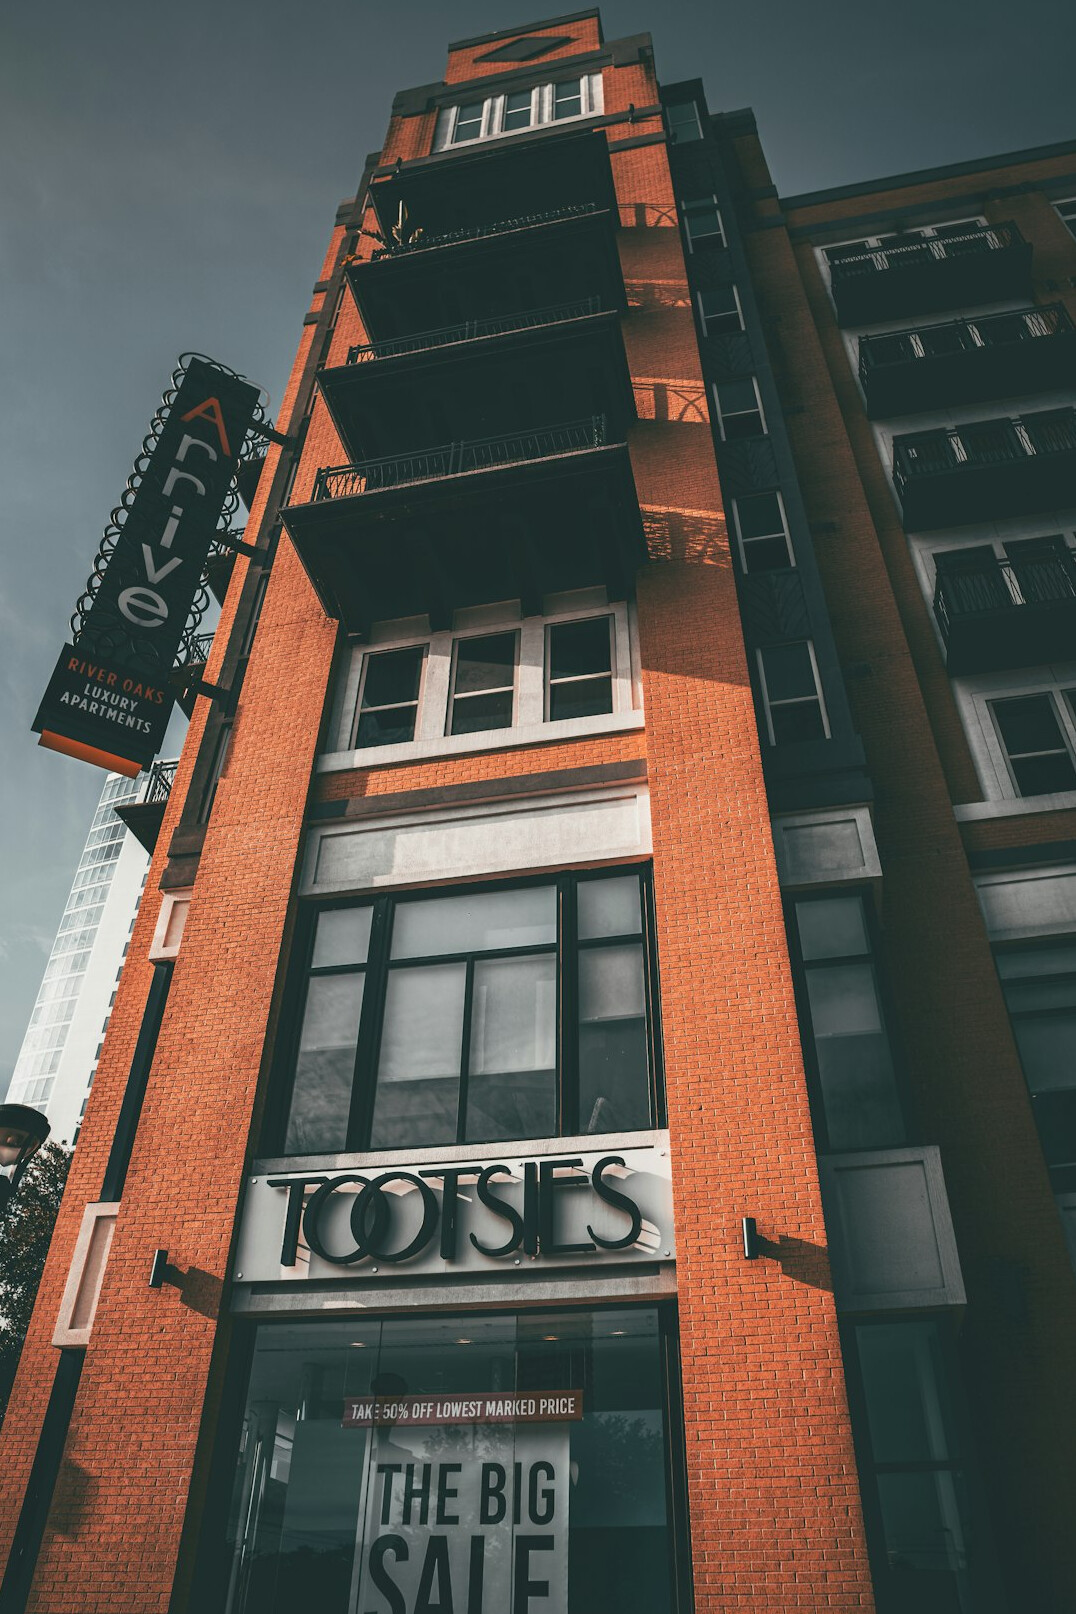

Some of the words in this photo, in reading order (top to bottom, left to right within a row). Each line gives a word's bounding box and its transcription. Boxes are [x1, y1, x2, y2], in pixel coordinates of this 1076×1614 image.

[118, 397, 231, 628] Arrive
[68, 657, 118, 686] RIVER
[122, 679, 165, 705] OAKS
[84, 683, 138, 712] LUXURY
[60, 691, 152, 734] APARTMENTS
[267, 1155, 642, 1267] TOOTSIES
[352, 1403, 379, 1420] TAKE
[382, 1402, 409, 1420] 50%
[412, 1402, 434, 1419] OFF
[436, 1401, 483, 1418] LOWEST
[485, 1399, 536, 1417] MARKED
[539, 1397, 575, 1415] PRICE
[377, 1463, 462, 1525] THE
[480, 1460, 555, 1526] BIG
